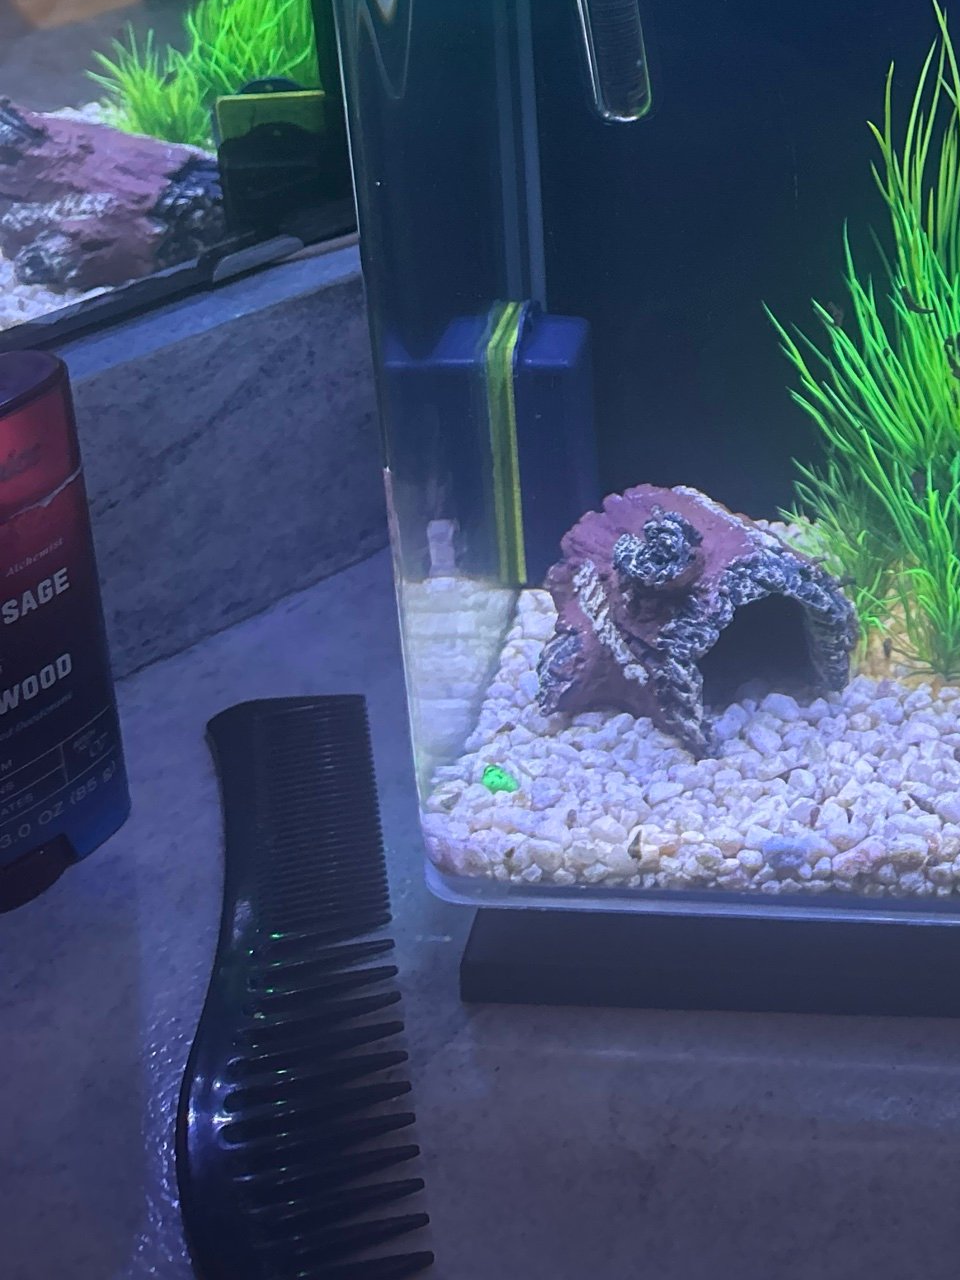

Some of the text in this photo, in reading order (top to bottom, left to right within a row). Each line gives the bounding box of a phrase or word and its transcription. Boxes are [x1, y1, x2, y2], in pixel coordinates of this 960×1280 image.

[1, 567, 70, 624] SAGE
[0, 653, 72, 714] WOOD
[38, 800, 65, 825] OZ
